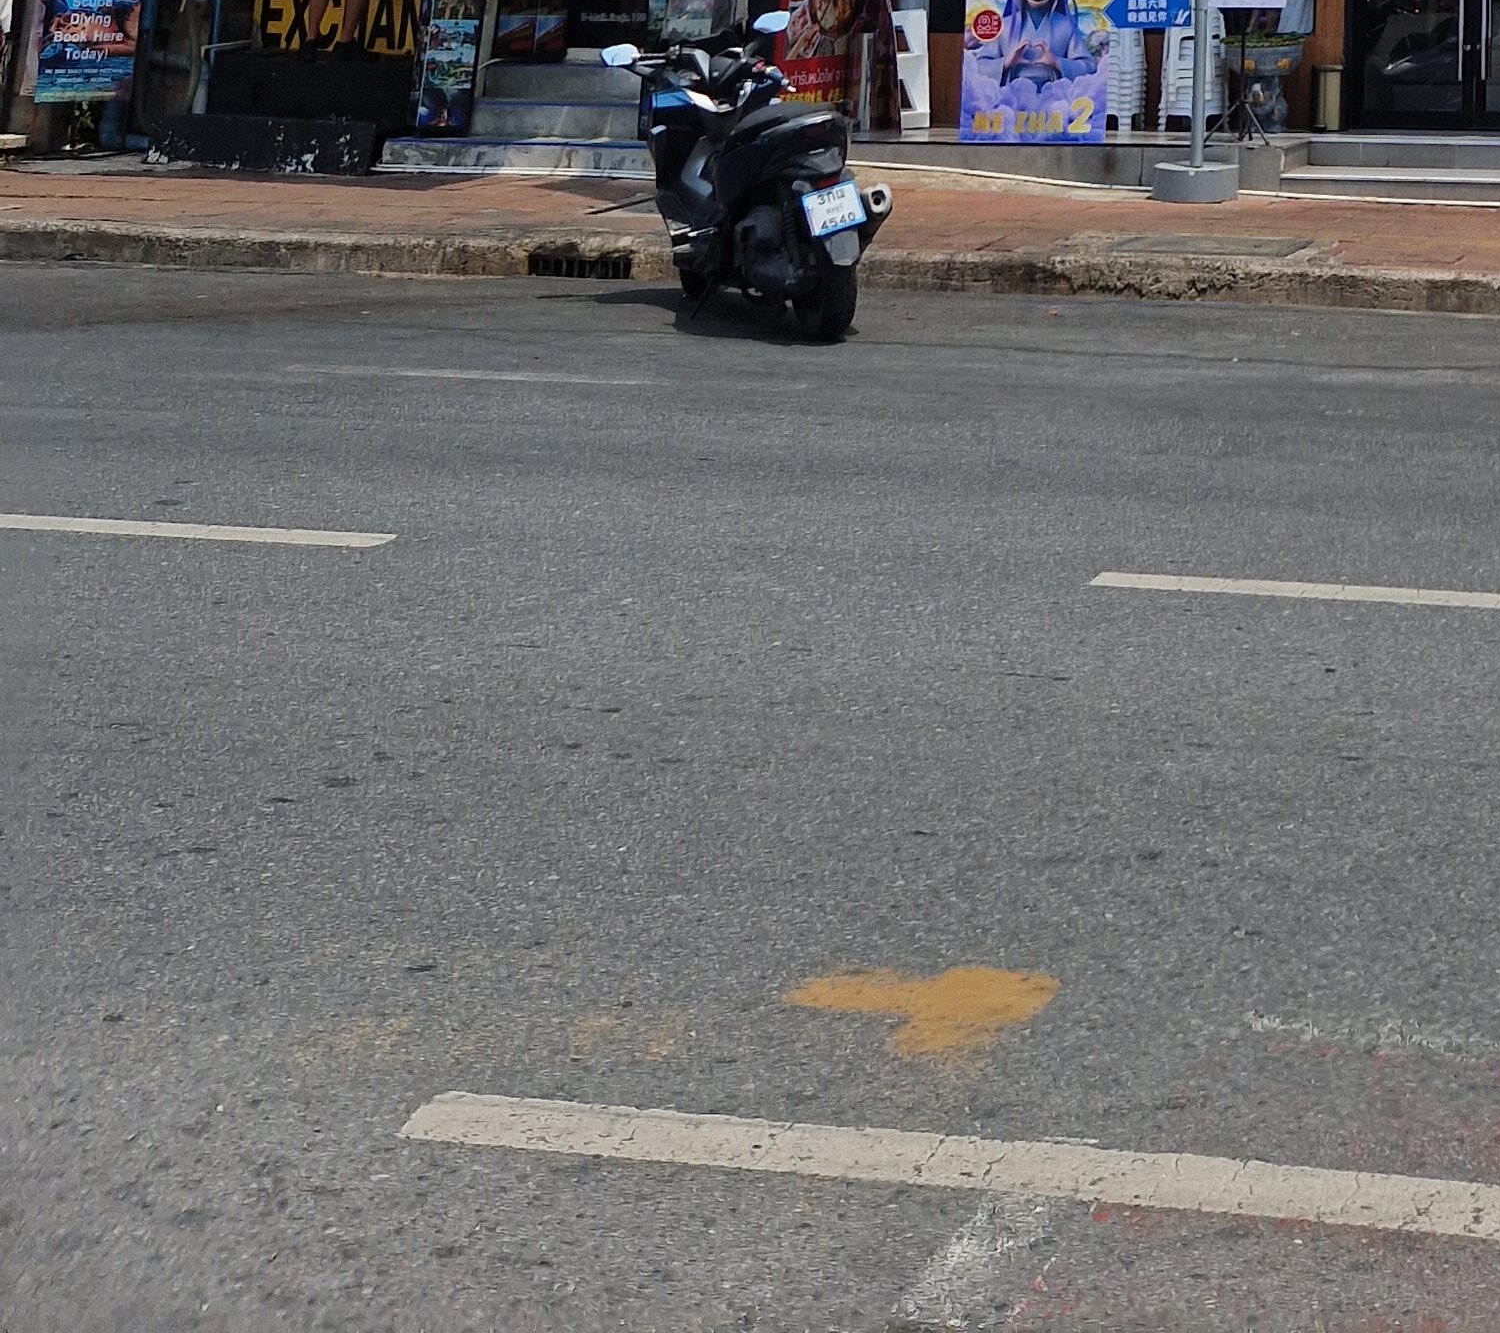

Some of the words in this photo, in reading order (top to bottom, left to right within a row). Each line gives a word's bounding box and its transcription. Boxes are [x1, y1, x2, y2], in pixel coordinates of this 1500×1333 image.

[70, 12, 112, 28] Diving
[53, 30, 88, 43] Book
[93, 30, 124, 43] Here
[64, 47, 109, 62] Today!
[1013, 110, 1064, 134] ZHA
[1067, 96, 1095, 134] 2
